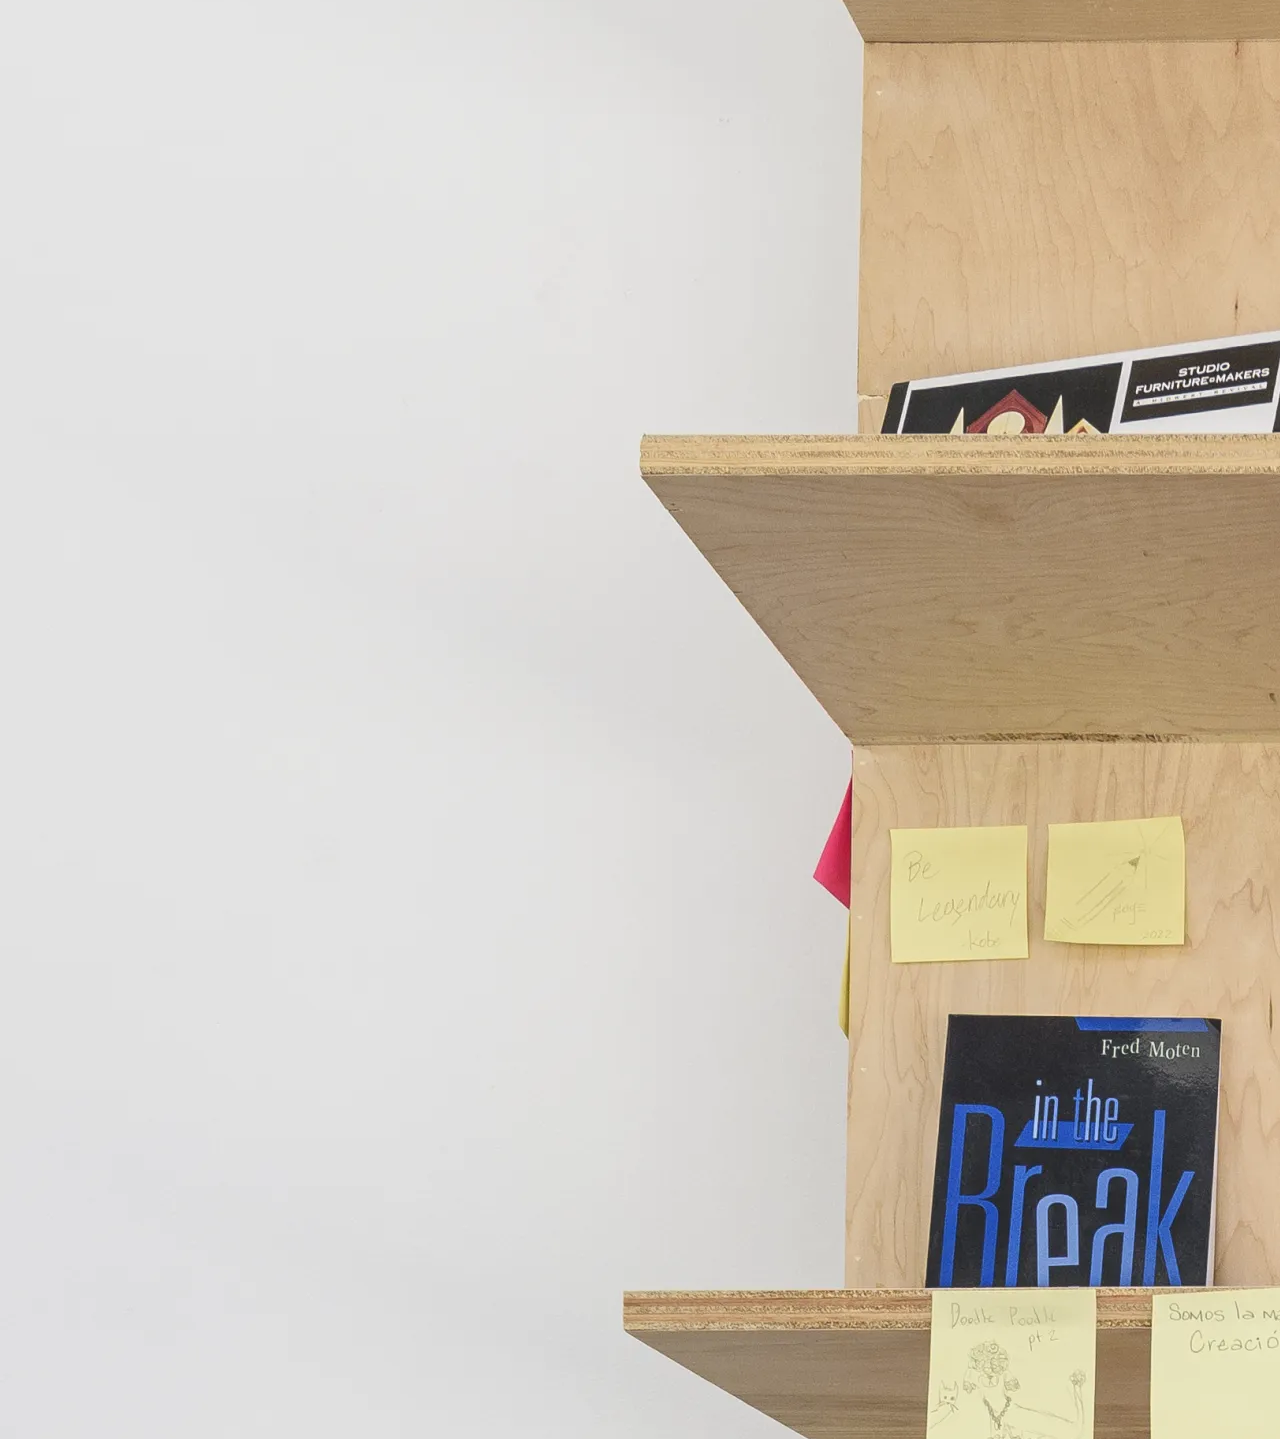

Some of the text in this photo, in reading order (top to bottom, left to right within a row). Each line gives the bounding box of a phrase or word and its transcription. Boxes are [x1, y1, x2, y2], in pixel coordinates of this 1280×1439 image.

[1101, 1038, 1200, 1060] Fred Moten
[1032, 1078, 1119, 1143] in the
[938, 1104, 1195, 1288] Break
